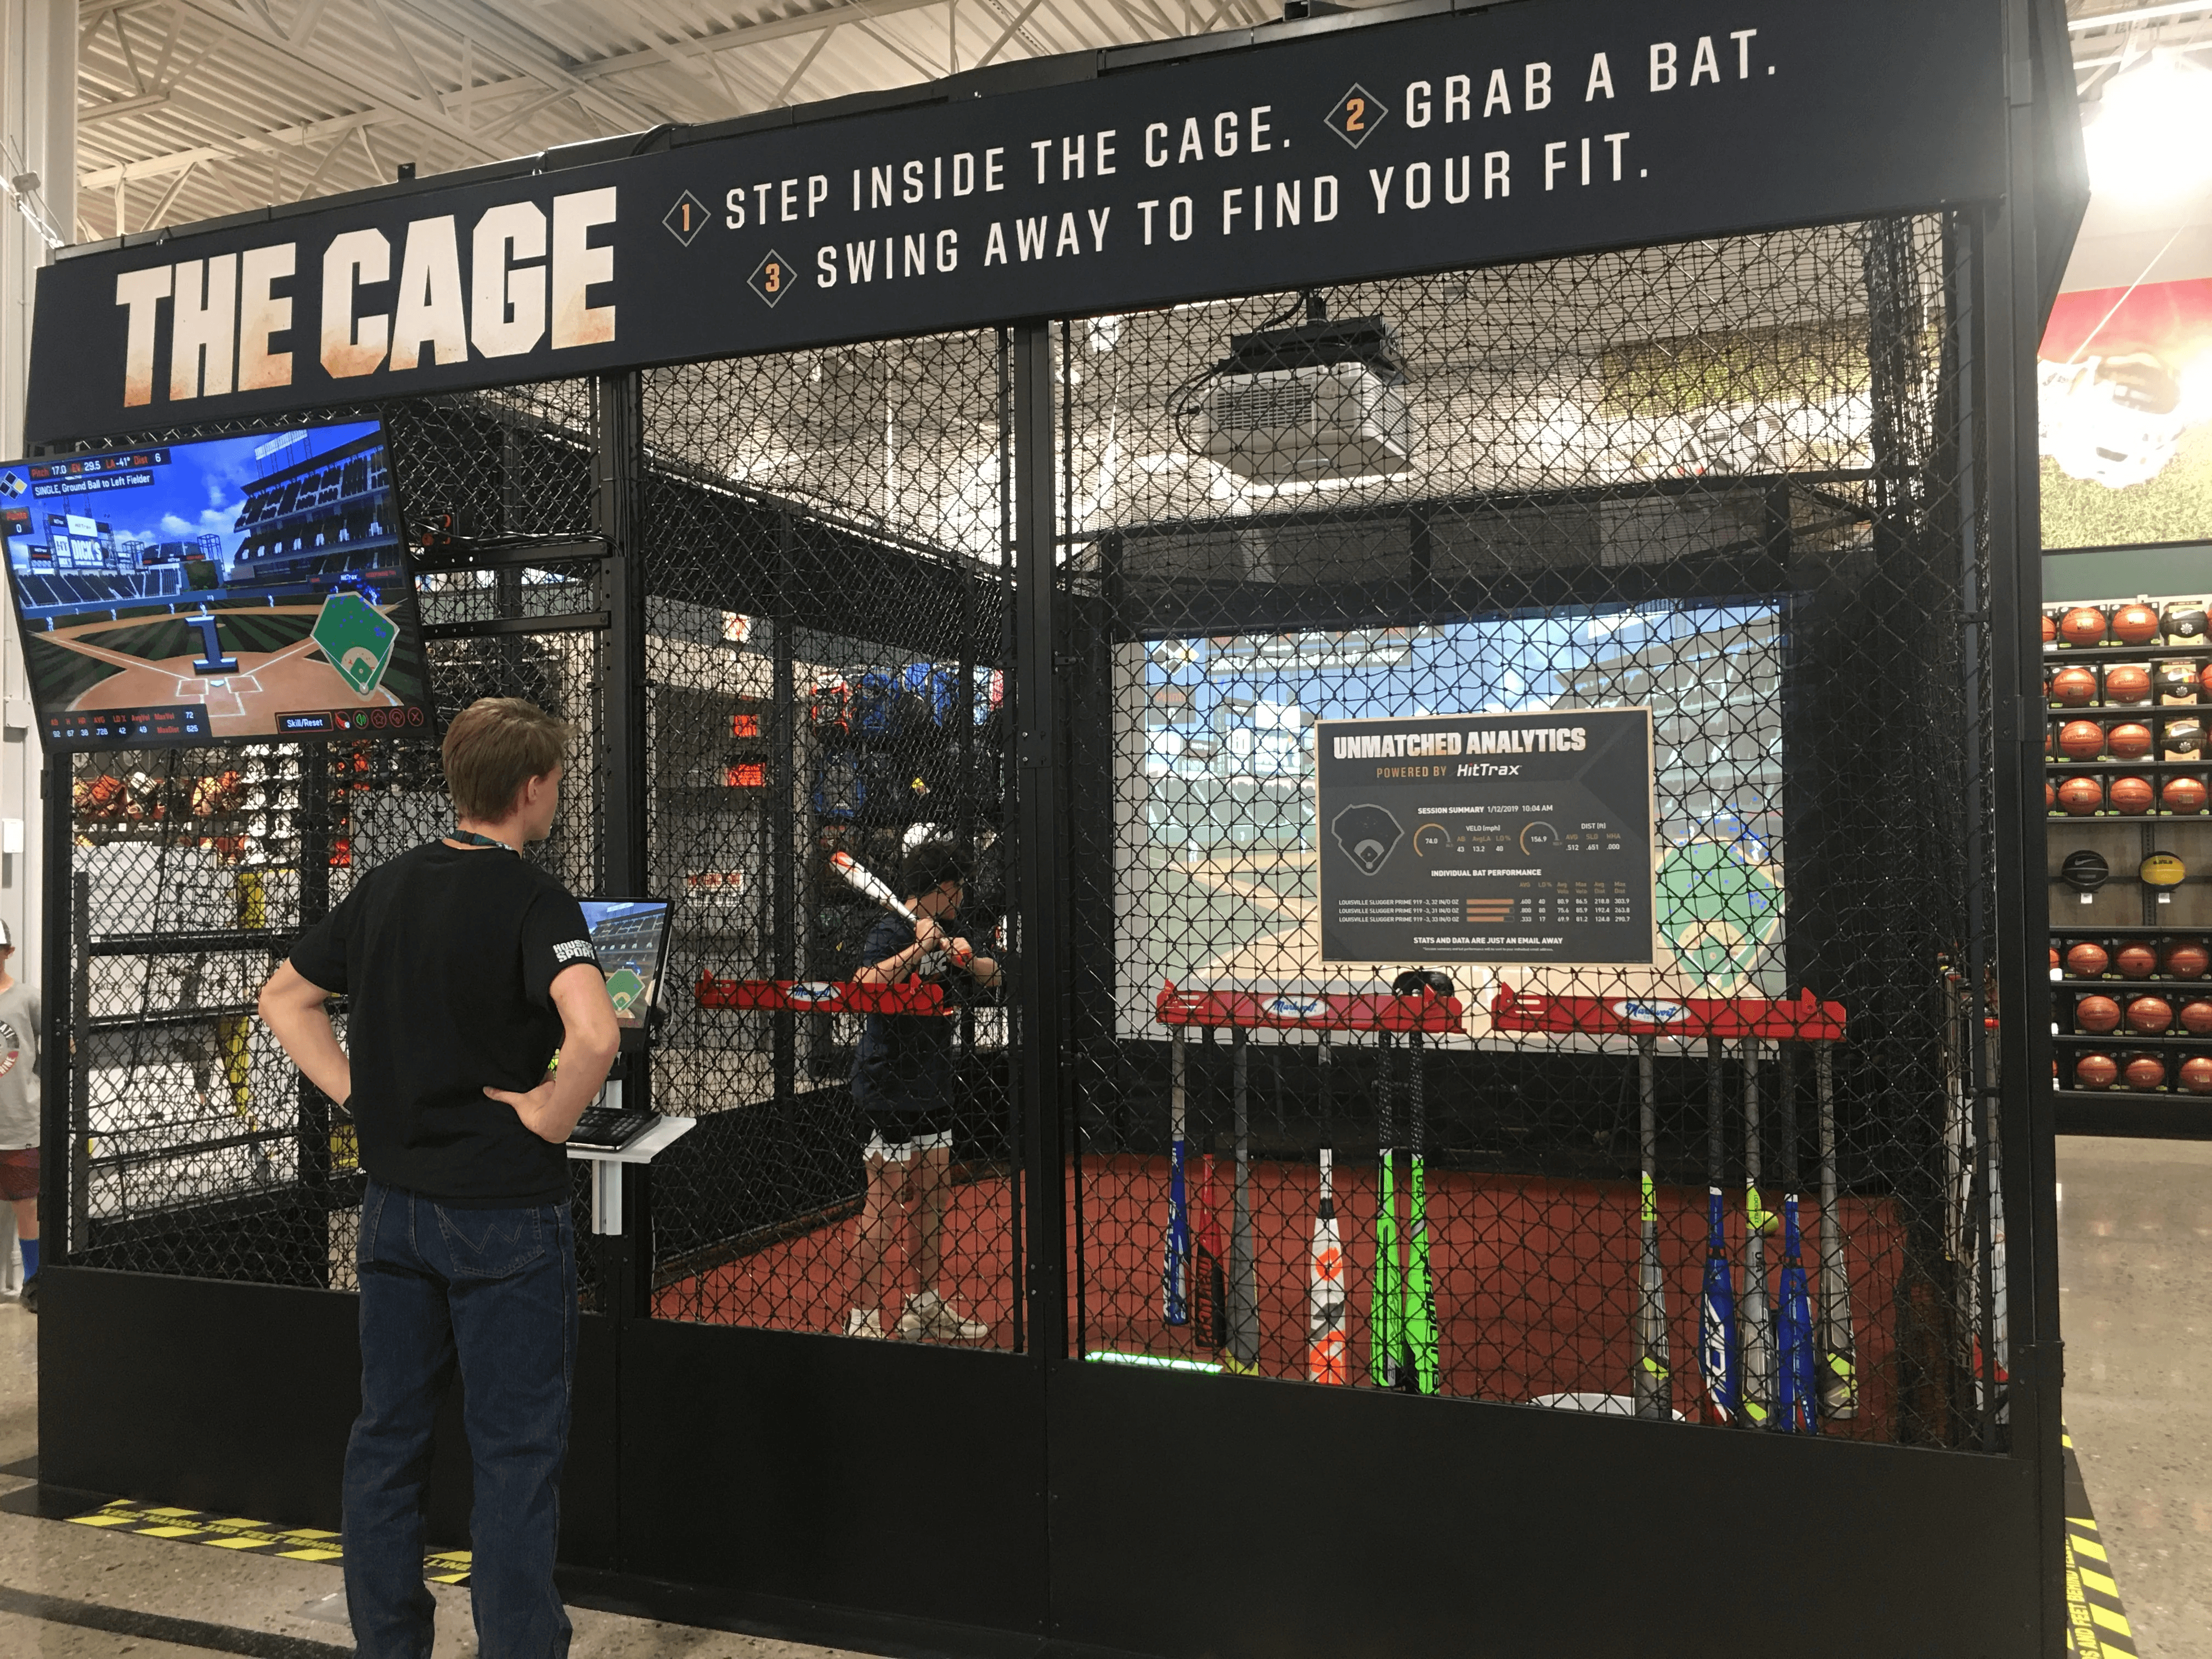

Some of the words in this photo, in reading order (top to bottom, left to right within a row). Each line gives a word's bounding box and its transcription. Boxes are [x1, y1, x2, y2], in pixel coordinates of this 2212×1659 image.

[682, 204, 690, 232] 1
[725, 174, 828, 230] STEP
[853, 147, 1004, 211] INSIDE
[1032, 129, 1116, 184] THE
[1145, 105, 1290, 168] CAGE.
[1347, 98, 1364, 131] 2
[1406, 61, 1551, 128] GRAB
[1585, 52, 1615, 101] A
[1650, 29, 1775, 93] BAT.
[765, 263, 780, 293] 3
[818, 229, 959, 289] SWING
[985, 207, 1111, 267] AWAY
[1138, 195, 1193, 246] TO
[1222, 175, 1338, 236] FIND
[1369, 150, 1510, 215] YOUR
[1545, 132, 1647, 191] FIT.
[116, 242, 296, 408] THE
[320, 186, 617, 379] CAGE
[52, 465, 67, 475] 17.0
[84, 461, 101, 472] 29.5
[155, 453, 161, 462] 6
[35, 484, 61, 496] SINGLE,
[62, 482, 86, 493] Ground
[88, 479, 101, 490] Ball
[101, 479, 110, 488] to
[111, 477, 125, 487] Left
[127, 474, 150, 485] Fielder
[16, 523, 22, 533] 0
[81, 728, 88, 736] 38
[119, 726, 126, 735] 42
[139, 725, 147, 733] 49
[286, 718, 323, 728] Skill/Reset
[1333, 732, 1462, 759] UNMATCHED
[1466, 727, 1586, 754] ANALYTICS
[1376, 766, 1429, 778] POWERED
[1433, 766, 1447, 776] BY
[1457, 763, 1521, 777] HitTrax
[556, 947, 595, 963] SPORT
[1416, 1175, 1424, 1199] UA
